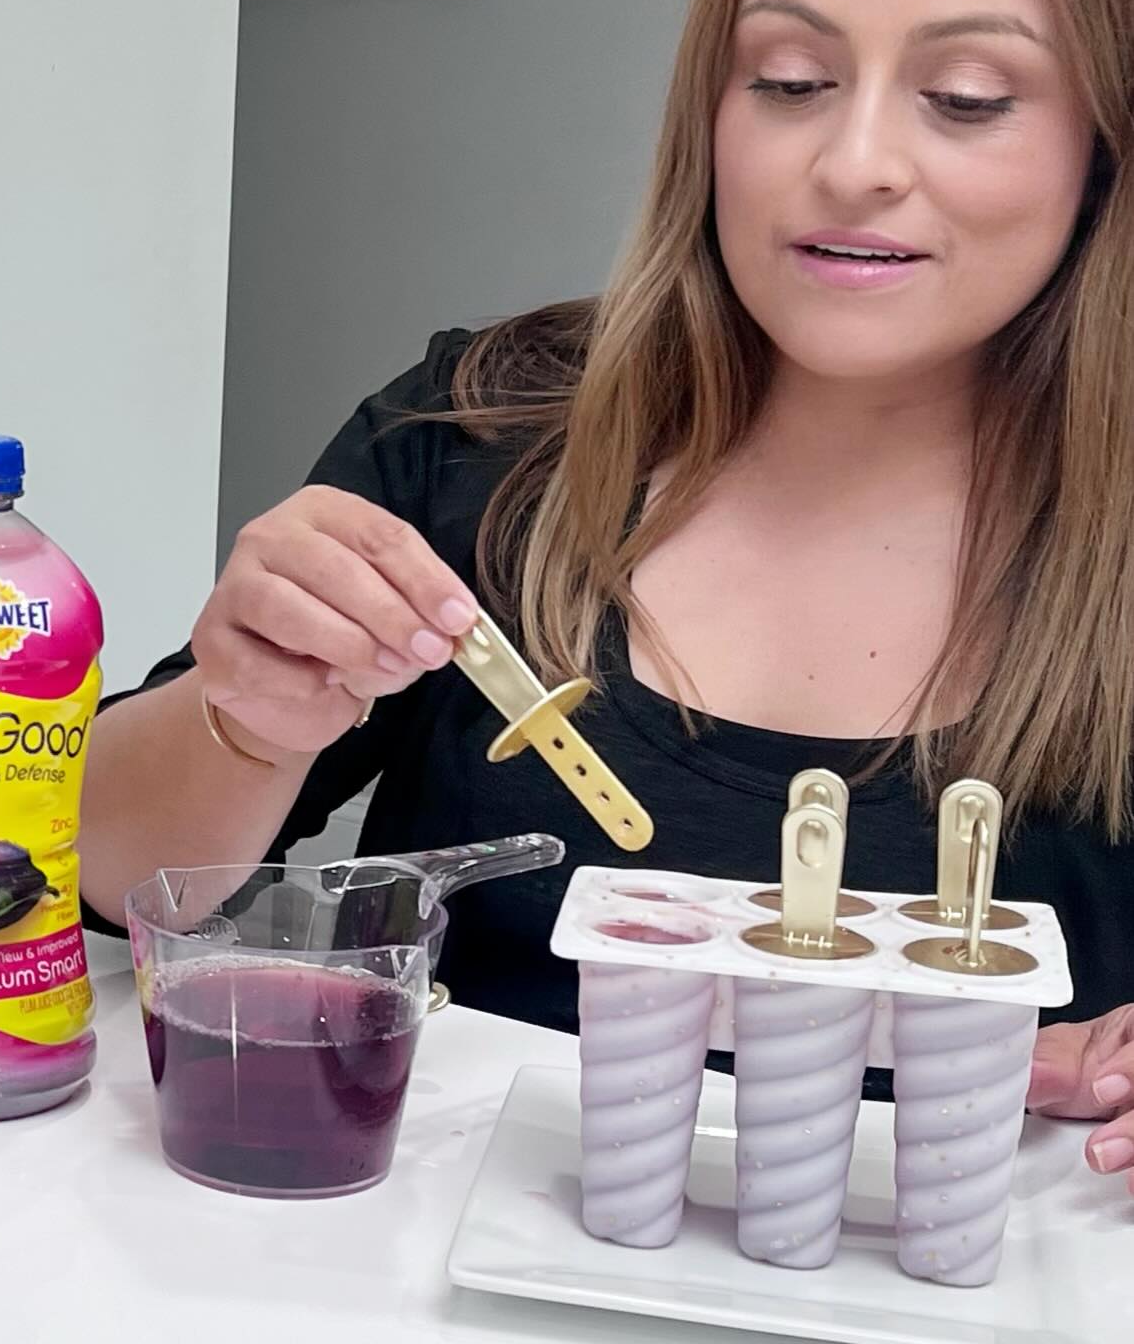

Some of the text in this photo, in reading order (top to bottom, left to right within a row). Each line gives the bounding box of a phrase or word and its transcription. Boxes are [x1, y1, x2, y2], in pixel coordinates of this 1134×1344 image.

[5, 764, 66, 783] Defense
[25, 947, 35, 959] &
[36, 931, 80, 957] Improved
[37, 950, 83, 982] Smart
